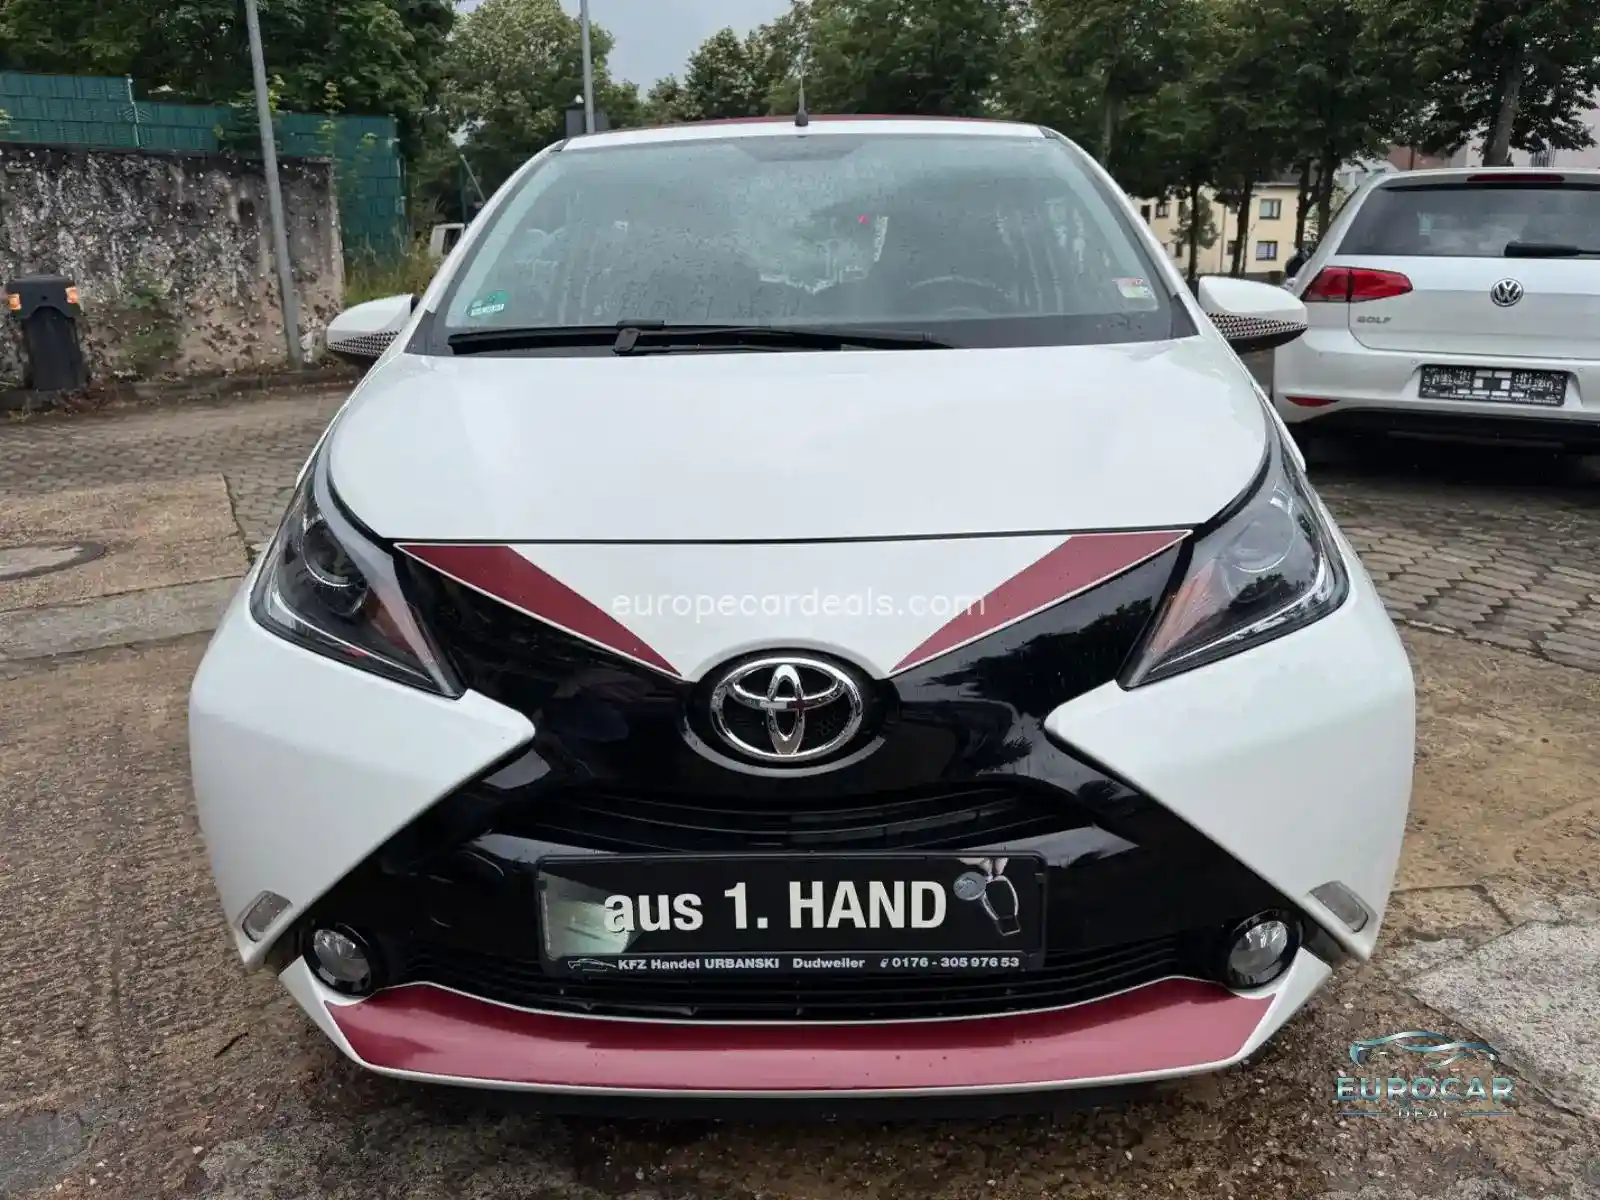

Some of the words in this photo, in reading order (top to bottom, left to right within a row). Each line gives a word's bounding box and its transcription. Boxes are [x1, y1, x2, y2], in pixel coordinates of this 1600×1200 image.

[1357, 315, 1391, 324] GOLF
[603, 893, 703, 932] aus
[724, 881, 769, 930] 1.
[789, 880, 947, 929] HAND
[618, 959, 647, 970] KFZ
[650, 958, 700, 969] Handel
[704, 957, 780, 969] URBANSKI
[892, 957, 929, 968] 0176
